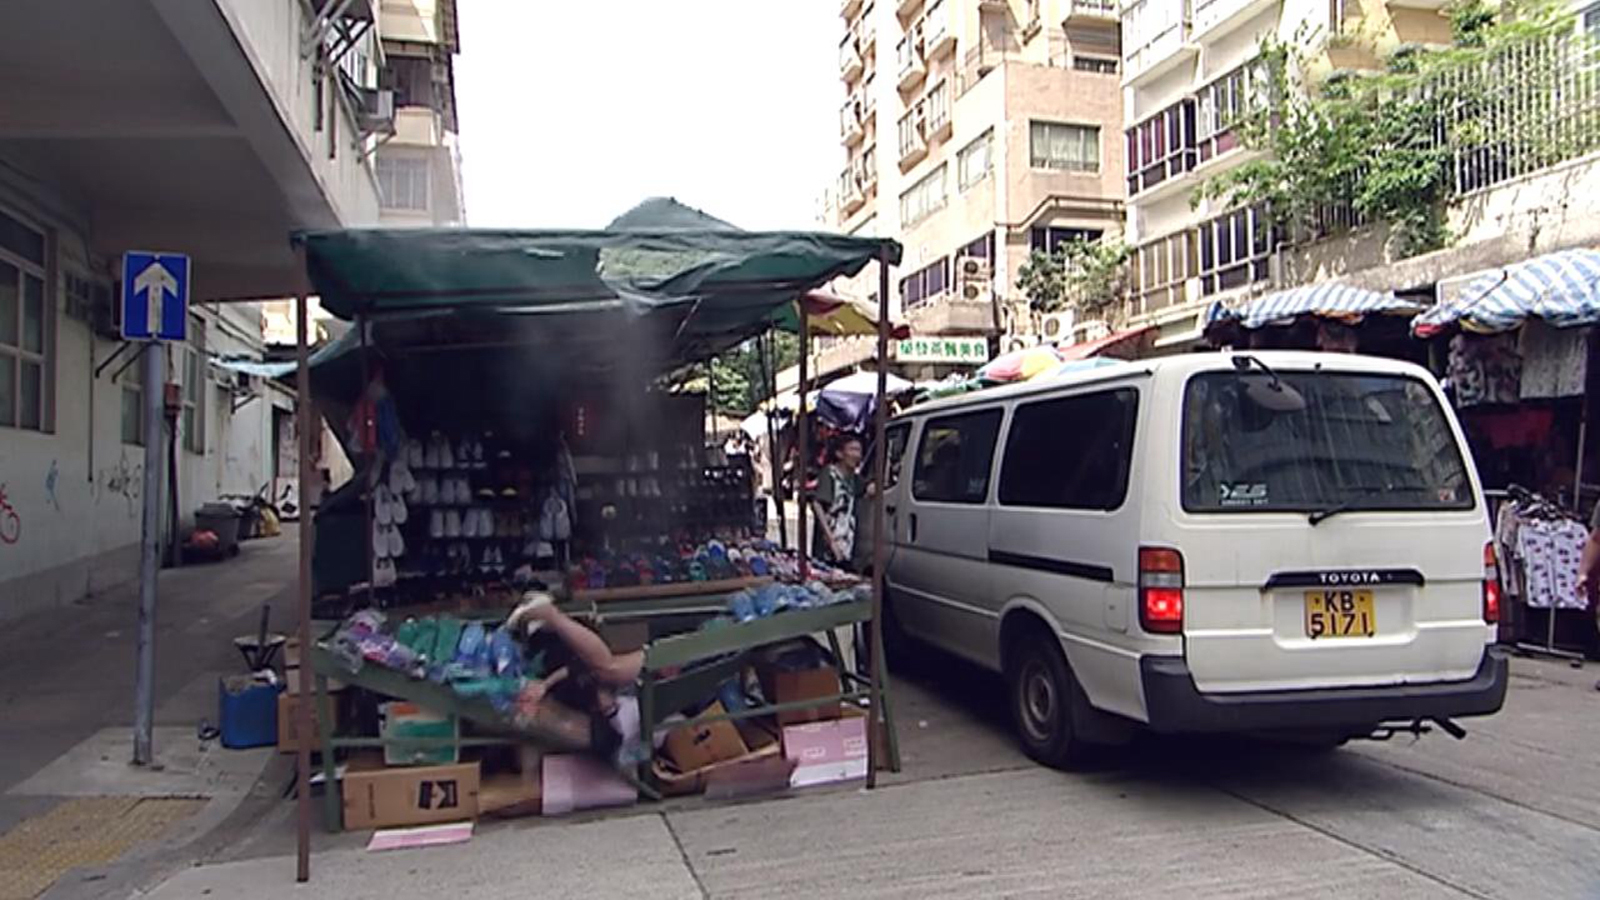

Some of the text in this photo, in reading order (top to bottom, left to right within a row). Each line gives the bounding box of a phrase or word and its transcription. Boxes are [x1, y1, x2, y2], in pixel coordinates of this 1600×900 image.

[1319, 572, 1381, 584] TOYOTA
[1324, 591, 1354, 612] KB
[1310, 612, 1368, 635] 5171
